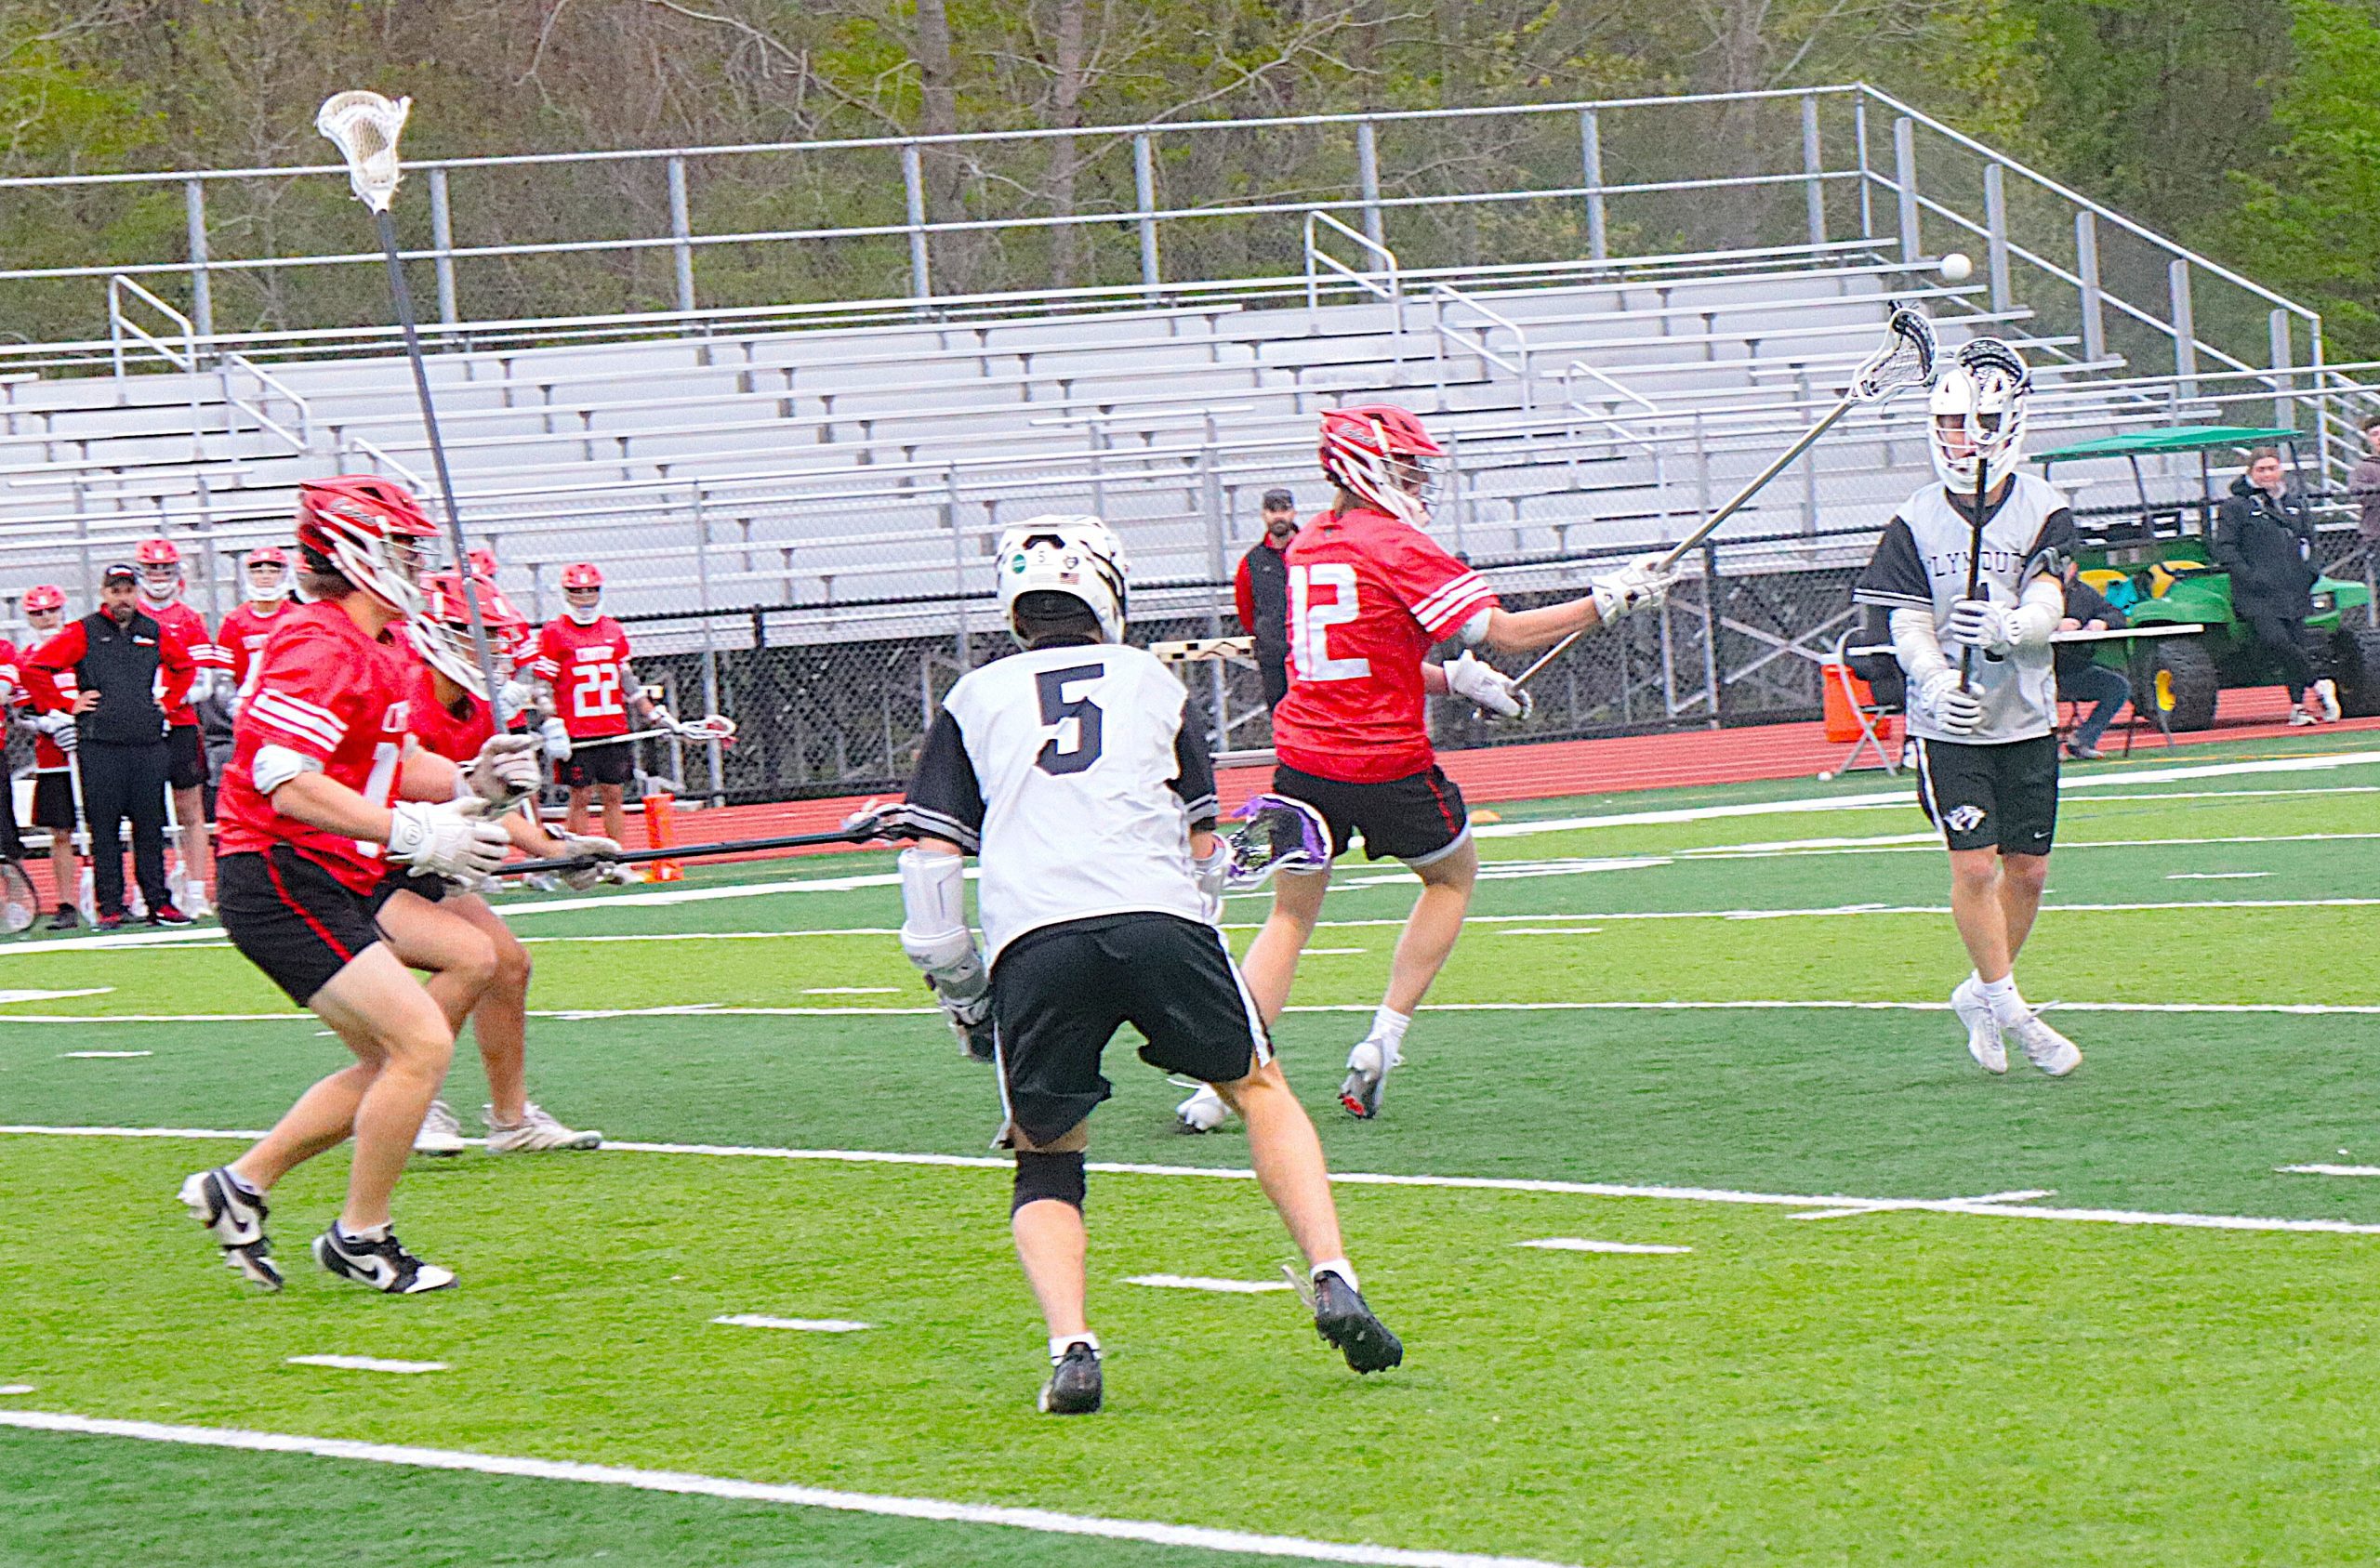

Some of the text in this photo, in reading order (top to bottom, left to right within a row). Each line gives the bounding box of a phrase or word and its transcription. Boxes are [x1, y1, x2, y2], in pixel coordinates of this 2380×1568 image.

[1924, 551, 2028, 576] LYOUT
[1288, 563, 1372, 681] 12
[571, 663, 624, 718] 22
[1033, 662, 1104, 776] 5
